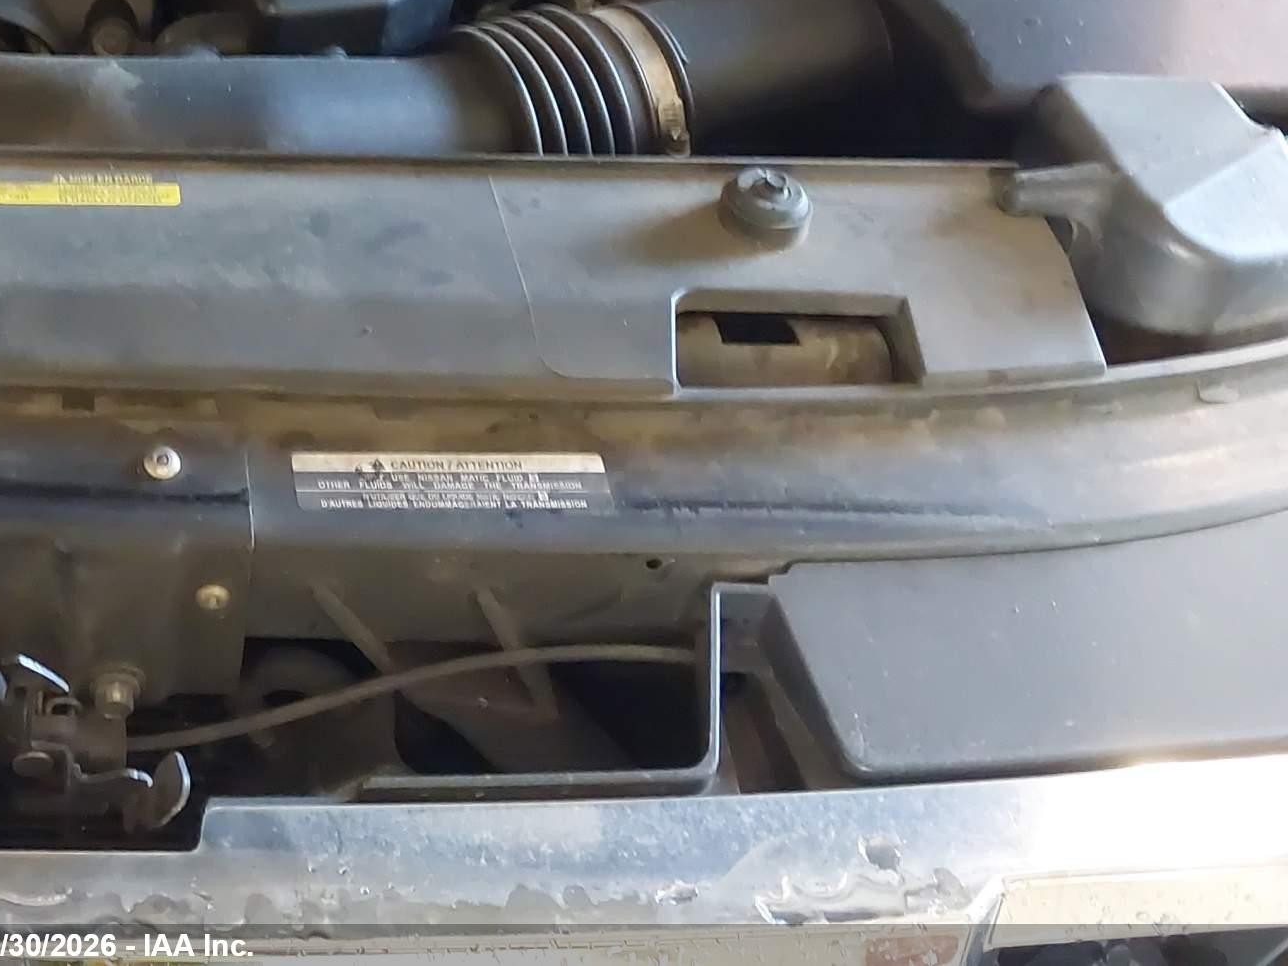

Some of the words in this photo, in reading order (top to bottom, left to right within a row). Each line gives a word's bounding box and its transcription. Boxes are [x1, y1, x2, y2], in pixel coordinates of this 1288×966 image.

[390, 459, 445, 470] CAUTION
[455, 459, 523, 471] ATTENTION
[496, 474, 523, 483] FLUID
[317, 480, 351, 490] OTHER
[359, 481, 393, 490] FLUIDS
[401, 481, 425, 490] WILL
[433, 481, 474, 490] DAMAGE
[483, 481, 501, 490] THE
[512, 481, 582, 490] TRANSMISSION
[320, 498, 364, 509] D'AUTRES
[367, 499, 409, 509] LIQUIDES
[505, 499, 518, 509] LA
[521, 499, 588, 509] TRANSMISSION
